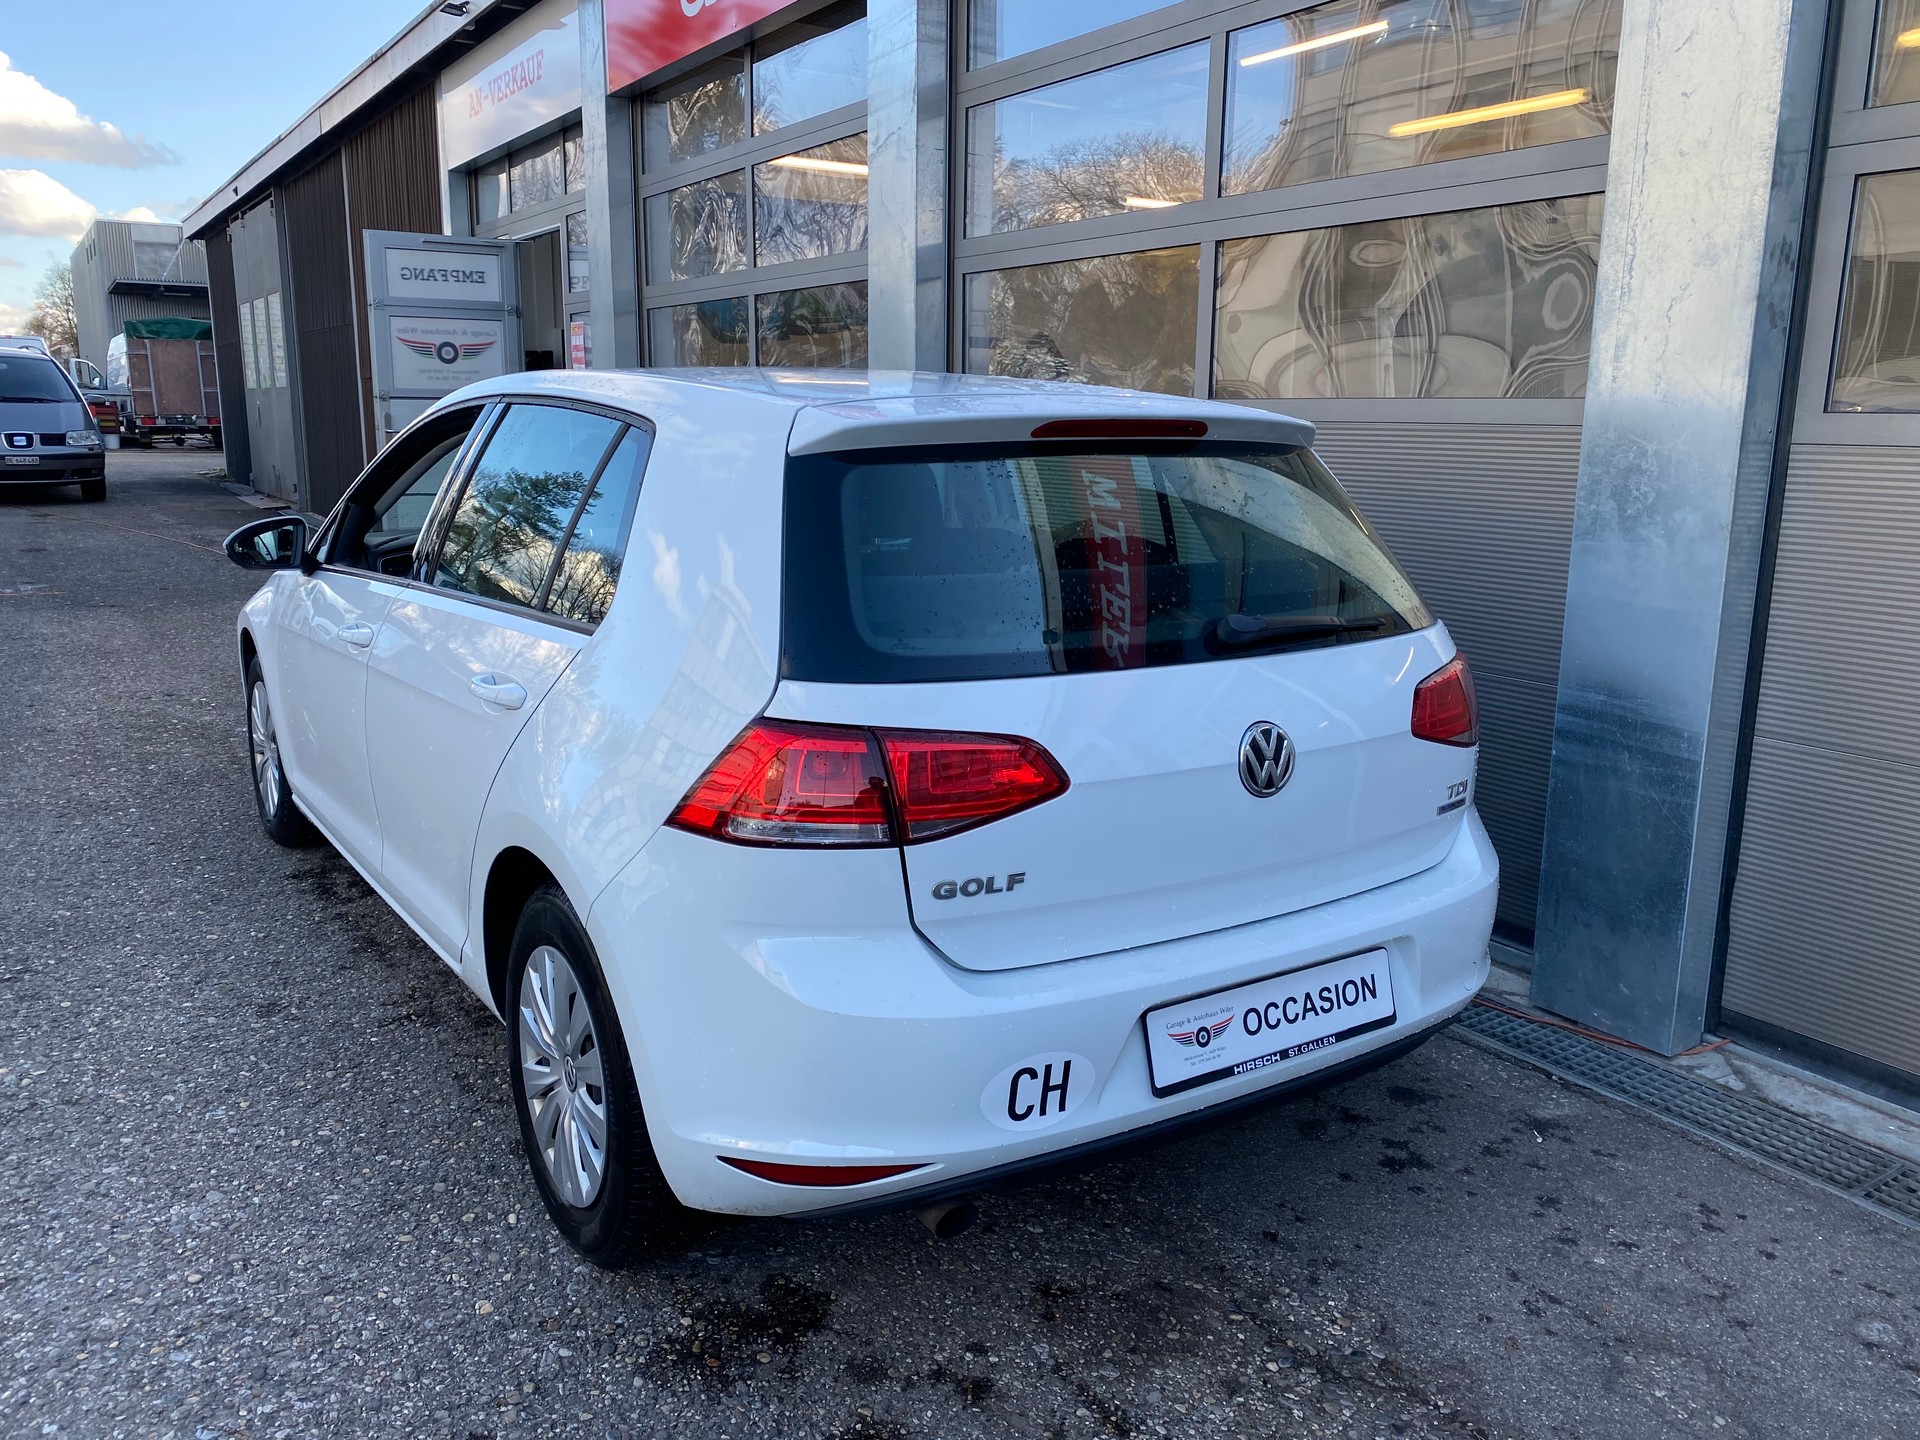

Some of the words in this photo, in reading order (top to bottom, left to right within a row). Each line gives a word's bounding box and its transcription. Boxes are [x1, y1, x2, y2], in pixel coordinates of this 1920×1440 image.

[468, 48, 544, 119] AN-VERKAUF
[1447, 778, 1468, 801] TDI
[931, 871, 1026, 900] GOLF
[1165, 1020, 1187, 1030] Garage
[1192, 1010, 1219, 1023] Autohaus
[1218, 1005, 1235, 1014] Wiler
[1242, 973, 1378, 1037] OCCASION
[1233, 1052, 1281, 1075] HIRSCH
[1007, 1059, 1072, 1122] CH
